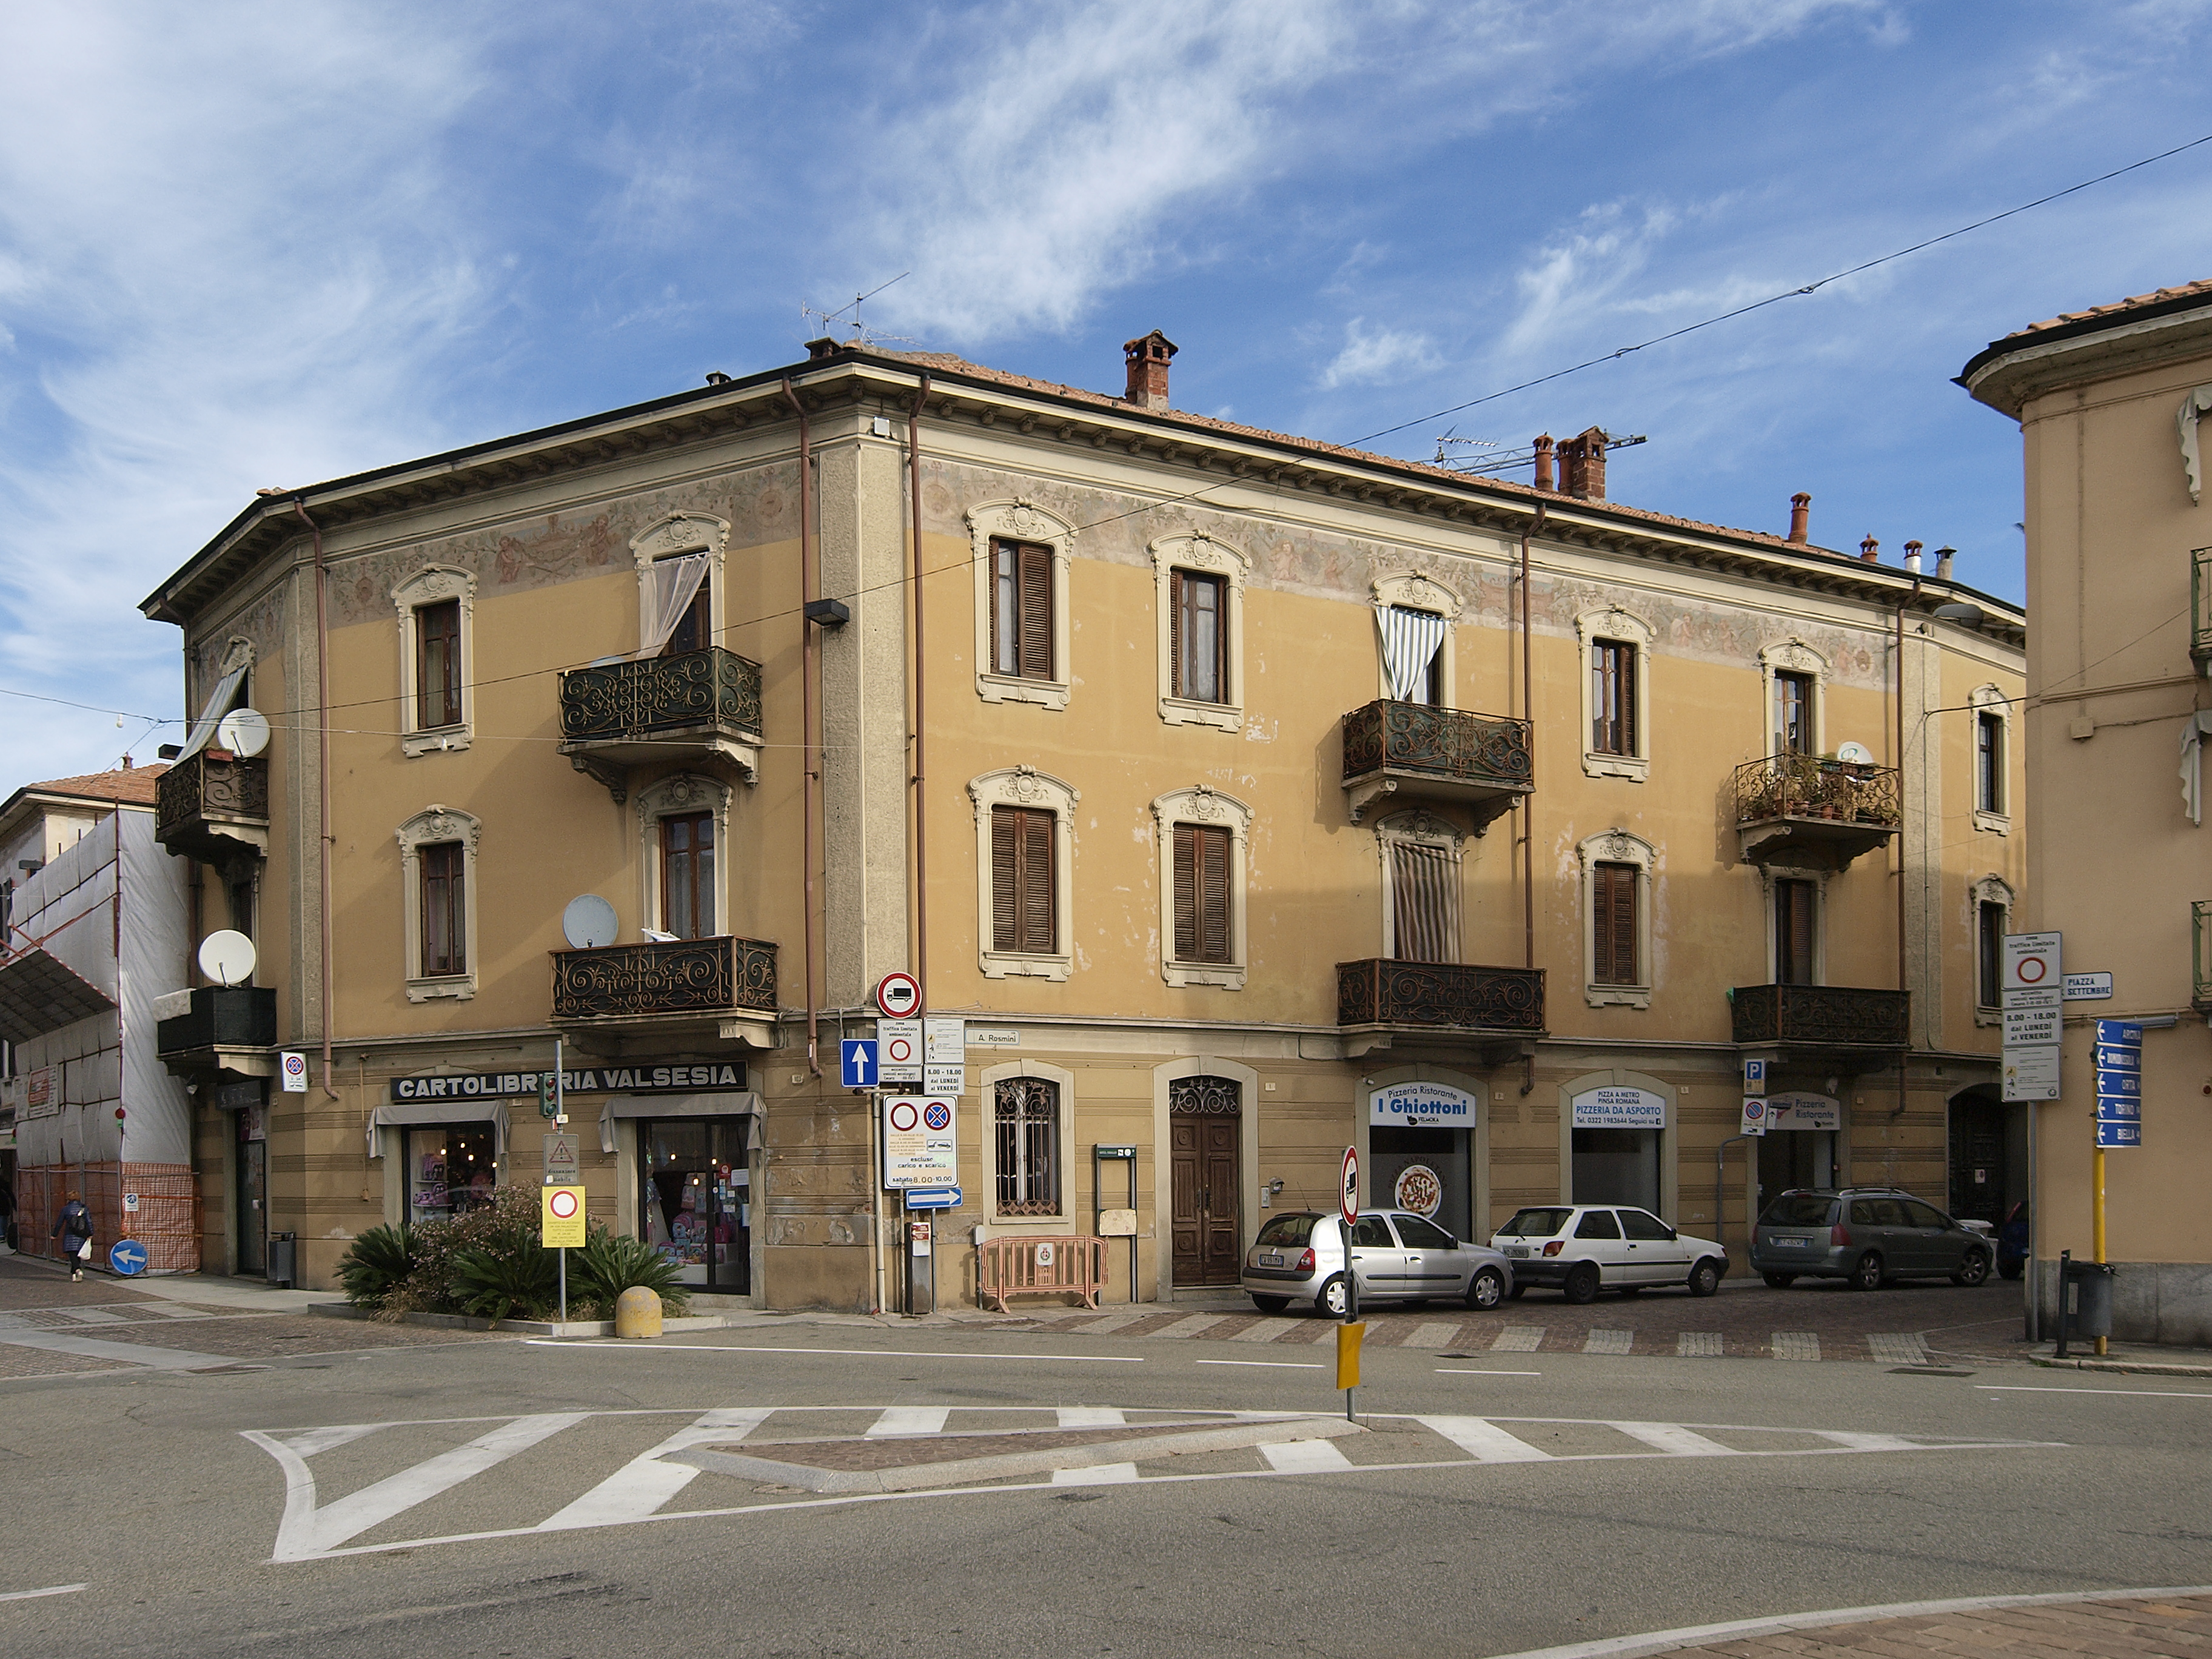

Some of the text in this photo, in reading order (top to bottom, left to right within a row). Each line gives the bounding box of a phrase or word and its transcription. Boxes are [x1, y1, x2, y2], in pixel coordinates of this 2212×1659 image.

[2067, 987, 2110, 996] SETTEMBRE
[399, 1065, 737, 1098] CARTOLIBRRIA VALSESIA
[1388, 1086, 1457, 1101] Pizzeria Ristorante
[1378, 1098, 1467, 1114] I Ghiottoni
[1795, 1099, 1826, 1108] Pizzeria
[1577, 1106, 1610, 1114] PIZZERIA
[1626, 1107, 1661, 1115] ASPORTO
[1795, 1110, 1834, 1119] Ristorante
